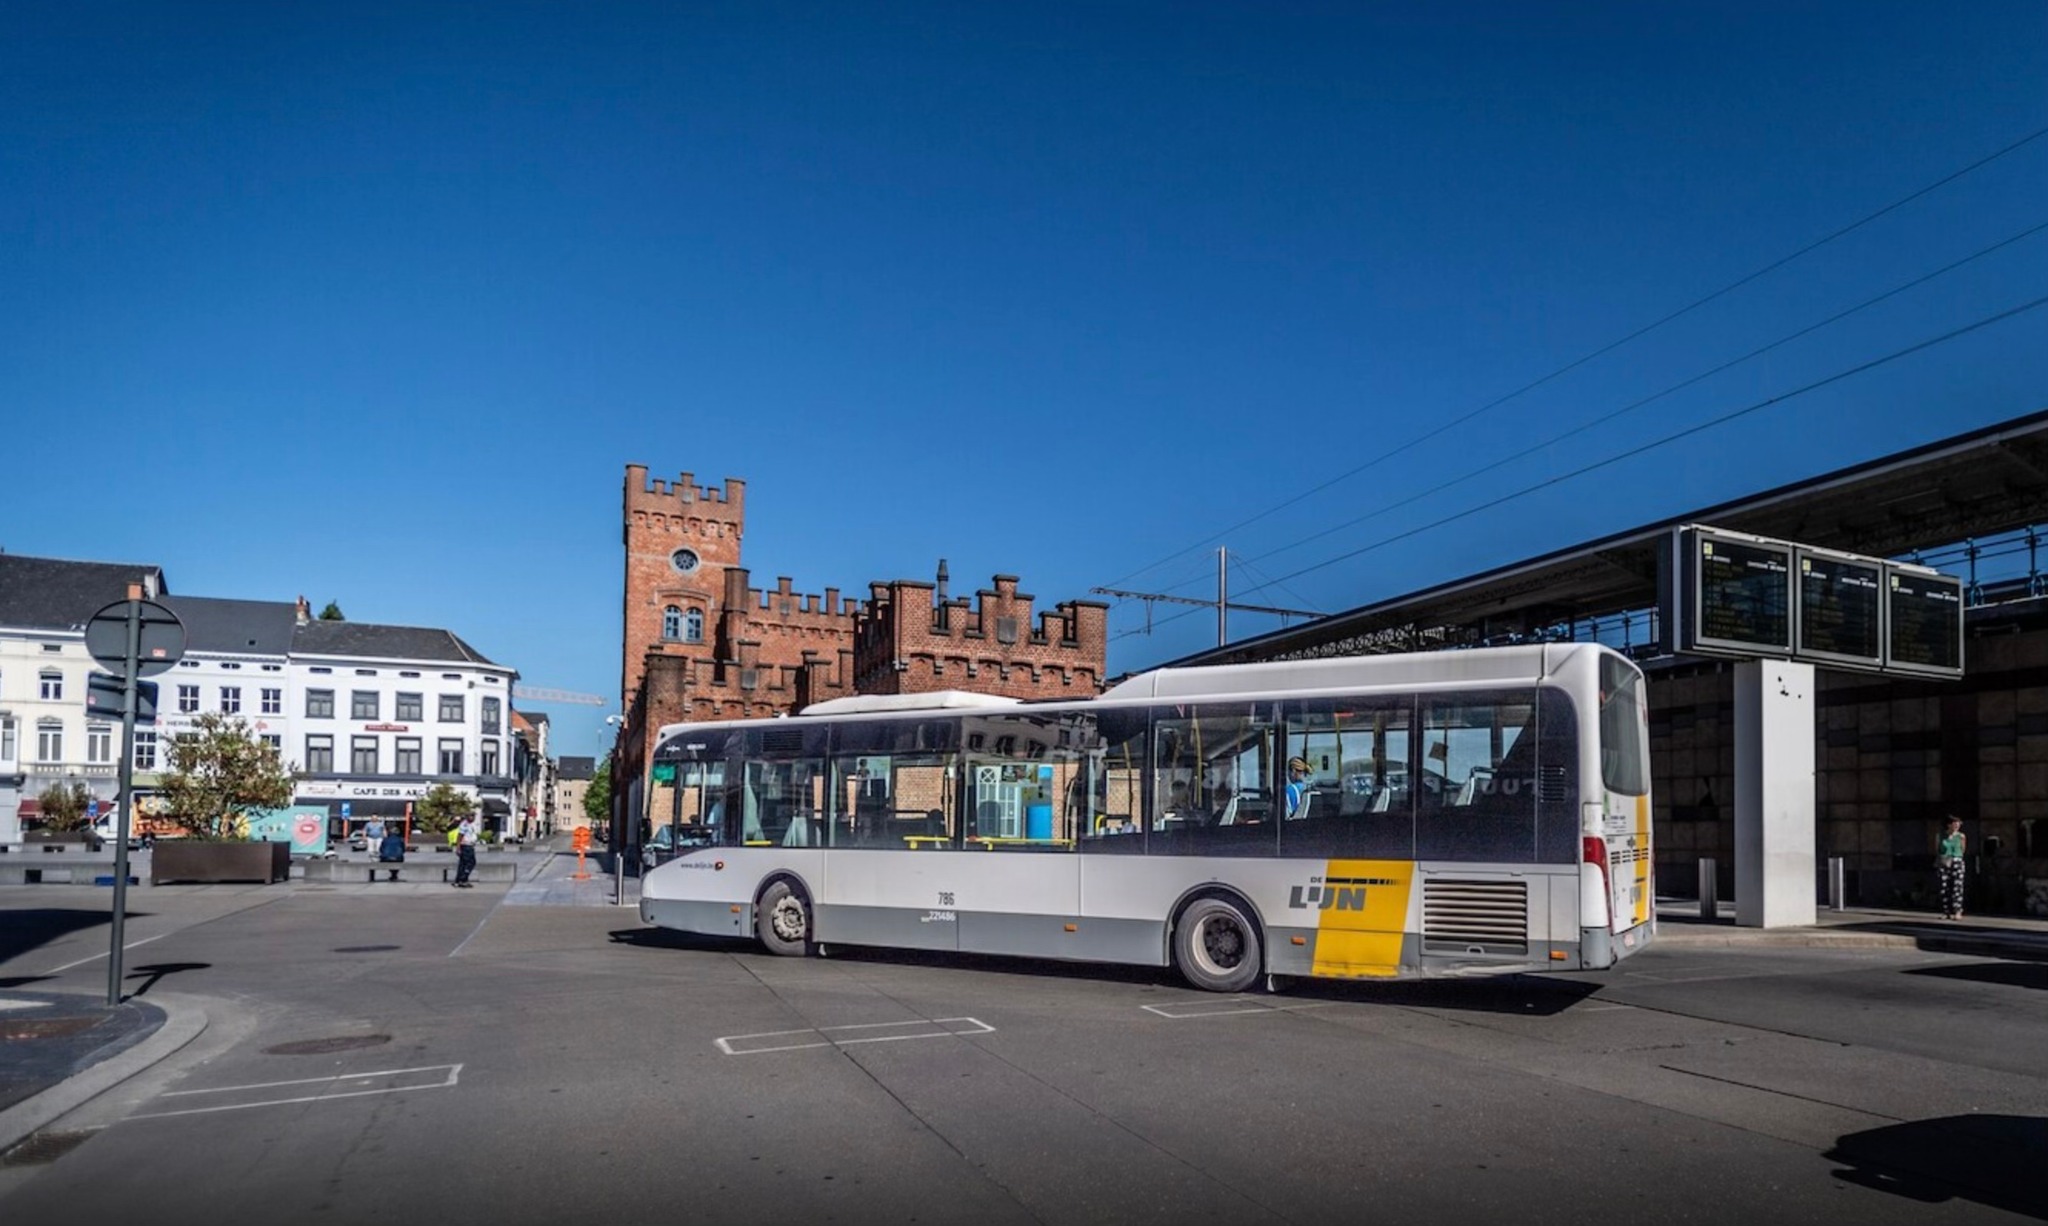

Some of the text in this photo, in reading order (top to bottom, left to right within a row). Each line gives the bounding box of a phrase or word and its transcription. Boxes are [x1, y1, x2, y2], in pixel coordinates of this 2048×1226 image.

[353, 787, 377, 796] CAFE
[382, 788, 401, 796] DES
[938, 891, 955, 906] 786
[1289, 886, 1367, 911] LIJN
